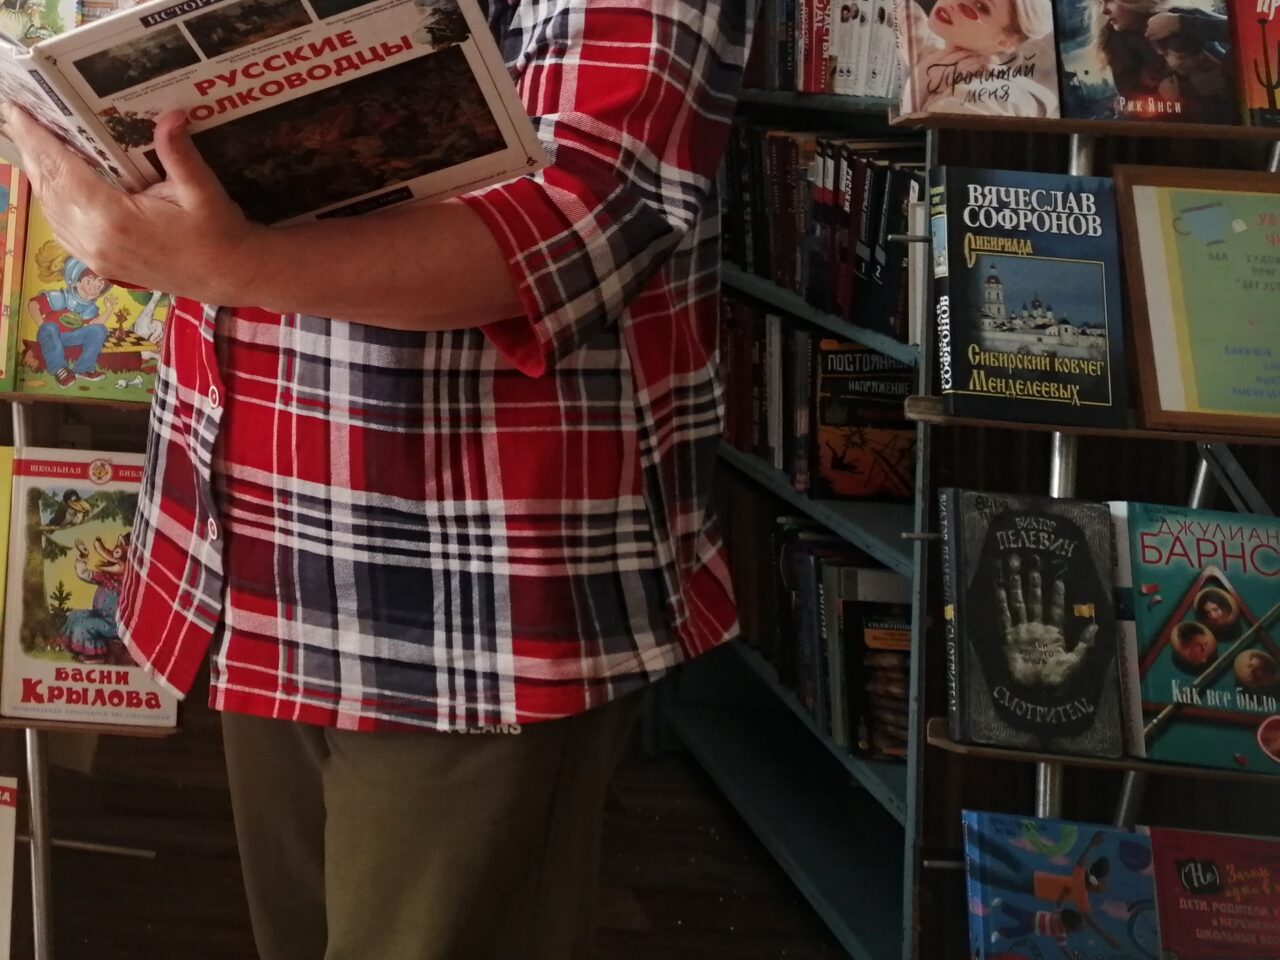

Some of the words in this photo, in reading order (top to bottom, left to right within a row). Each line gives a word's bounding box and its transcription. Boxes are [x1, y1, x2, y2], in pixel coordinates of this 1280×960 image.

[186, 35, 414, 124] ОЛКОВОДЦЫ
[194, 30, 358, 97] РУССКИЕ
[967, 184, 1096, 215] ВЯЧЕСЛАВ
[963, 206, 1103, 237] СОФРОНОВ
[30, 463, 82, 475] ШКОЛЬНАЯ
[996, 531, 1076, 557] ПЕЛЕВИН
[993, 685, 1095, 724] СМОТРИТЕЛЬ
[1171, 679, 1202, 706] Как
[1206, 686, 1232, 708] все
[1236, 686, 1278, 713] было
